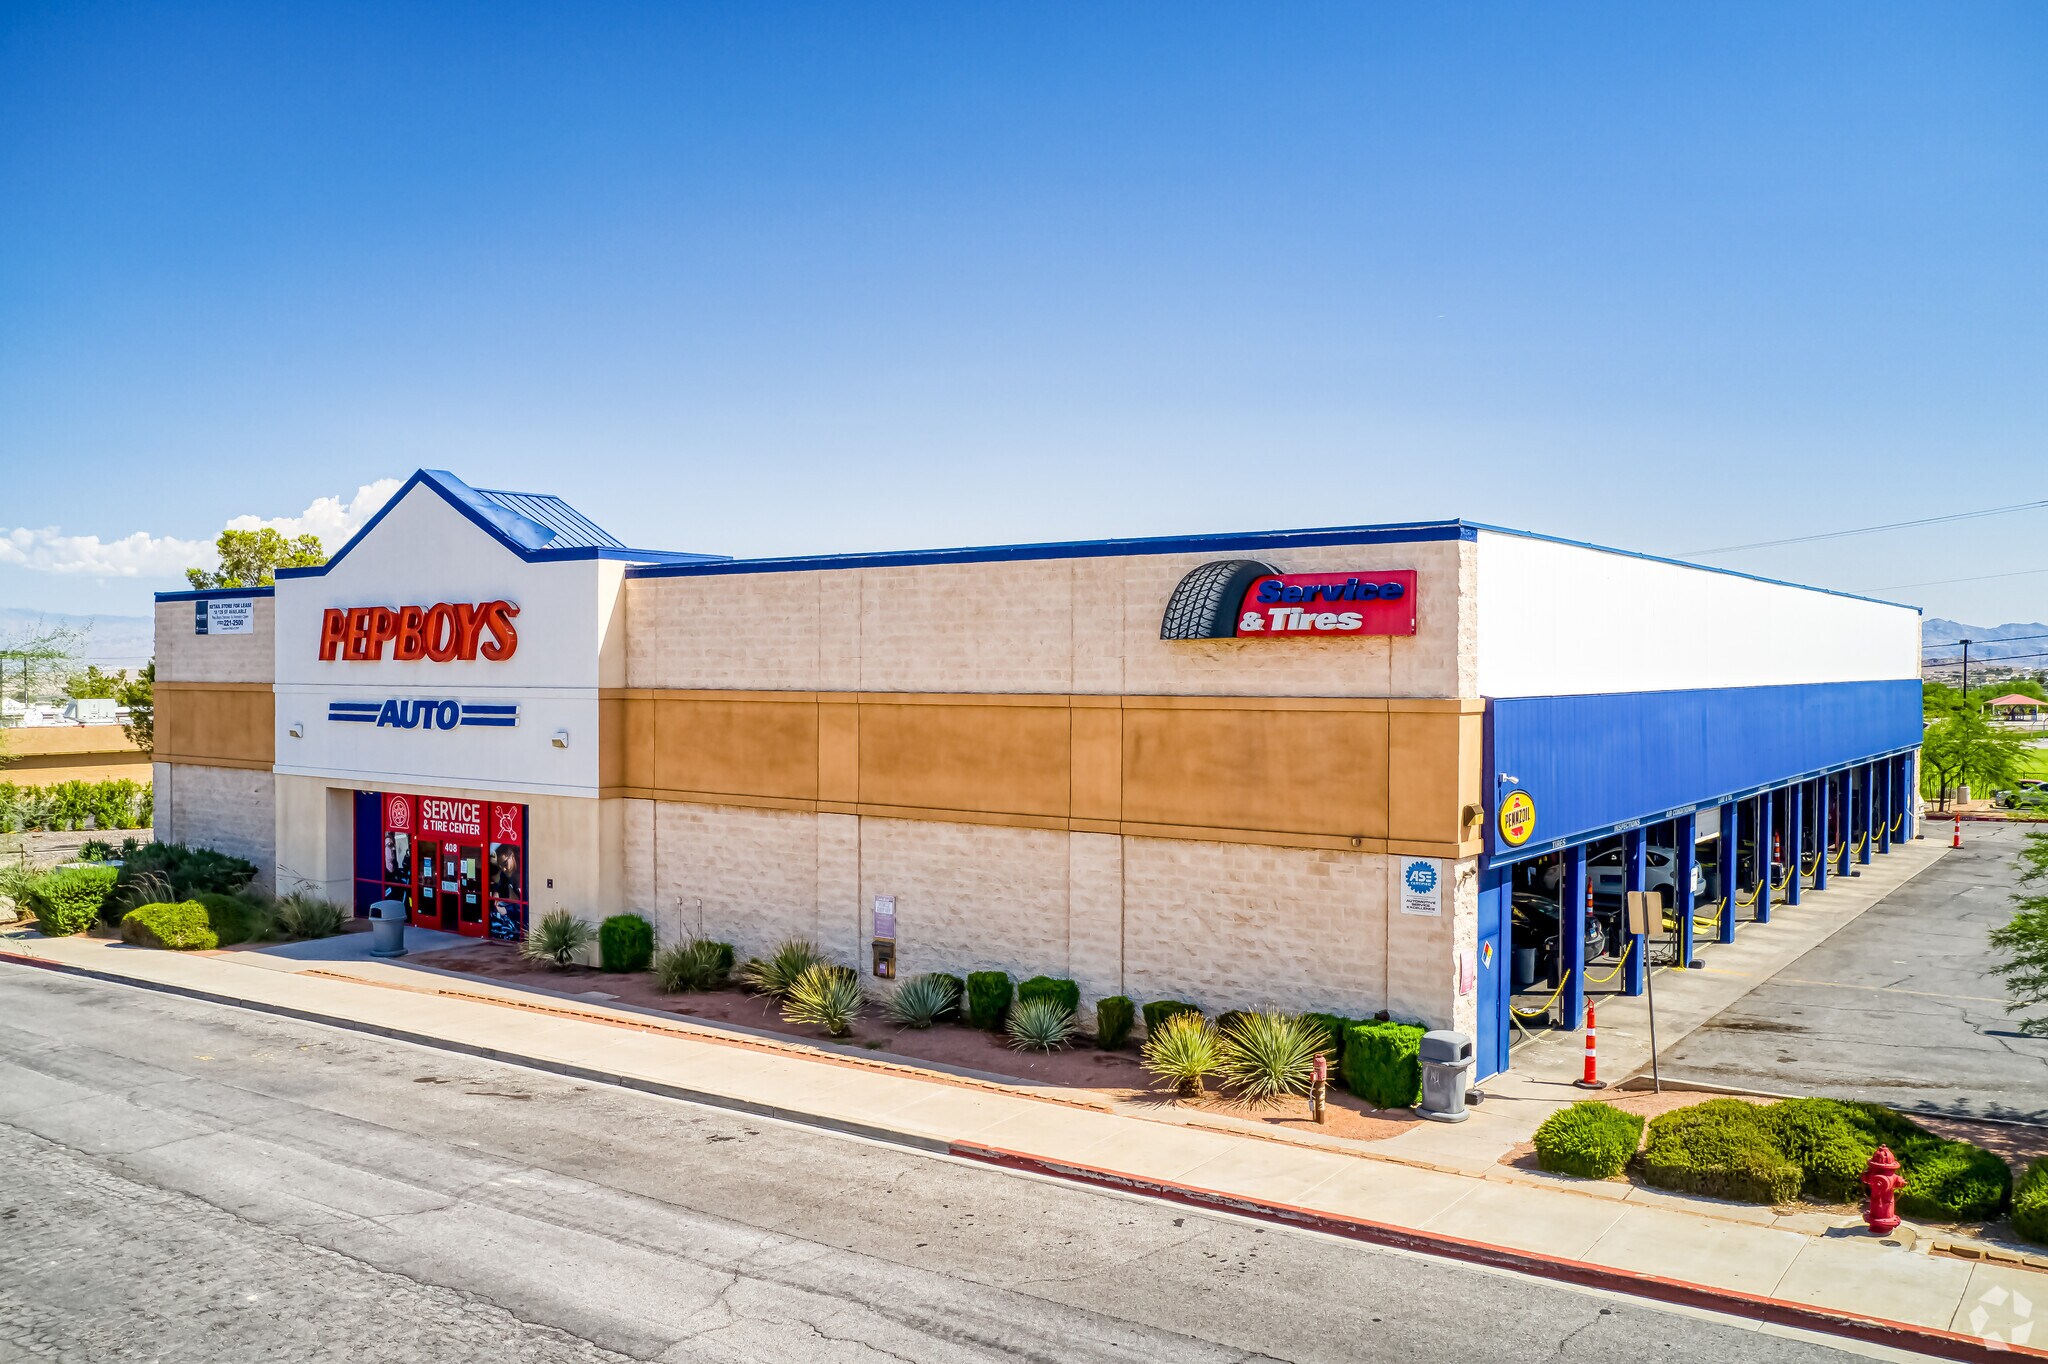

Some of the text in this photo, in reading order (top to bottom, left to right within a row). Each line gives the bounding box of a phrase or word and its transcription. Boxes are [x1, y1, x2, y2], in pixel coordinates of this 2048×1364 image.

[1257, 578, 1404, 604] Service
[1239, 607, 1363, 632] & Tires
[377, 700, 460, 731] AUTO
[423, 800, 480, 823] SERVICE
[1504, 806, 1531, 829] PENNZOIL
[423, 819, 480, 836] & TIRE CENTER
[1613, 819, 1641, 832] INSPECTIONS
[445, 843, 457, 852] 408
[1552, 838, 1567, 849] TIRES
[1409, 870, 1432, 883] ASE
